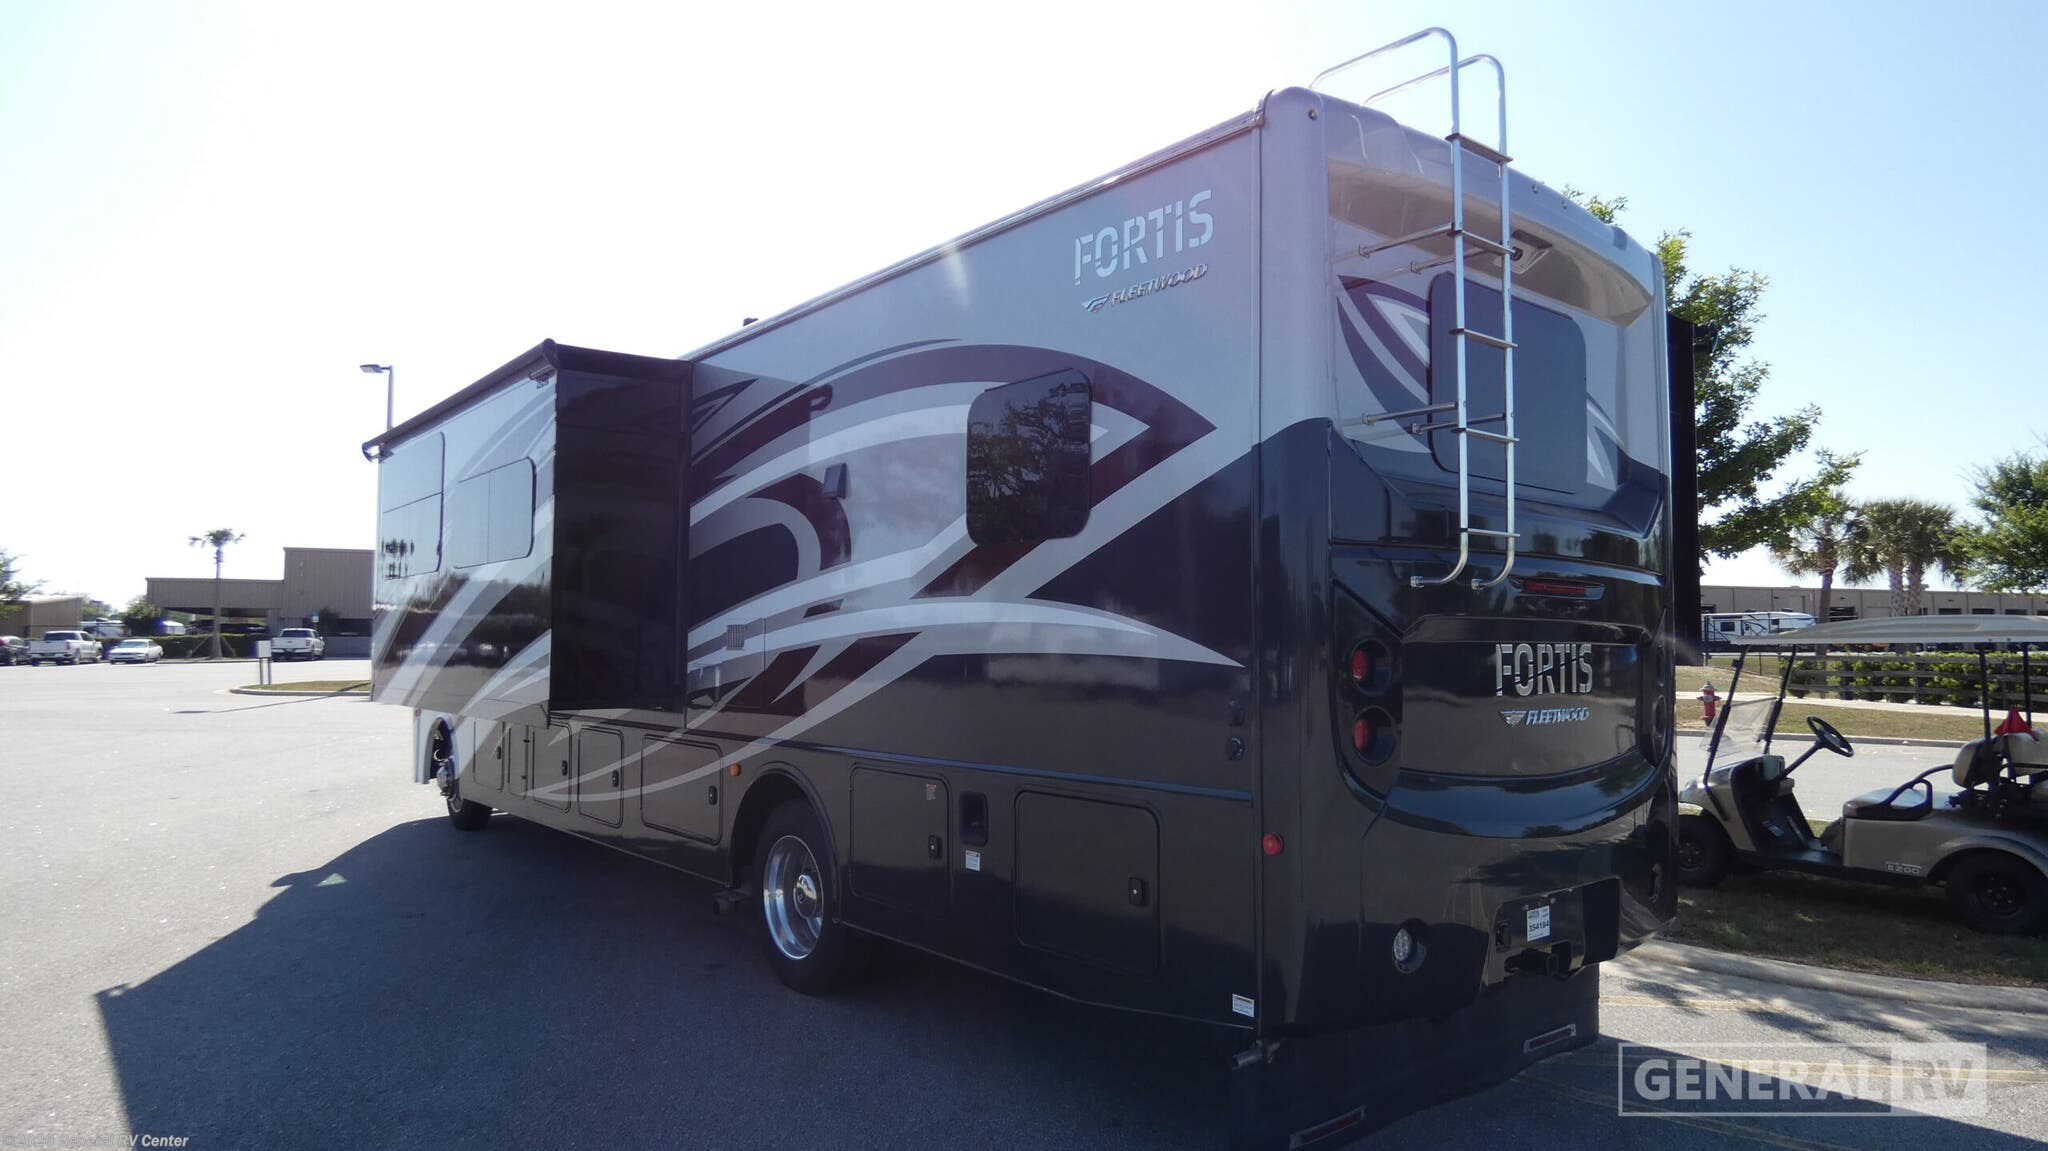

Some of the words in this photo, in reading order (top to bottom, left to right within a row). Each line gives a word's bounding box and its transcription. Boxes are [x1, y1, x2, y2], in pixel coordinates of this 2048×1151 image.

[1074, 188, 1214, 286] FORTIS
[1112, 263, 1209, 305] FLEETWOOD
[1495, 643, 1593, 697] FORTIS
[1525, 707, 1590, 726] FLEETWOOD
